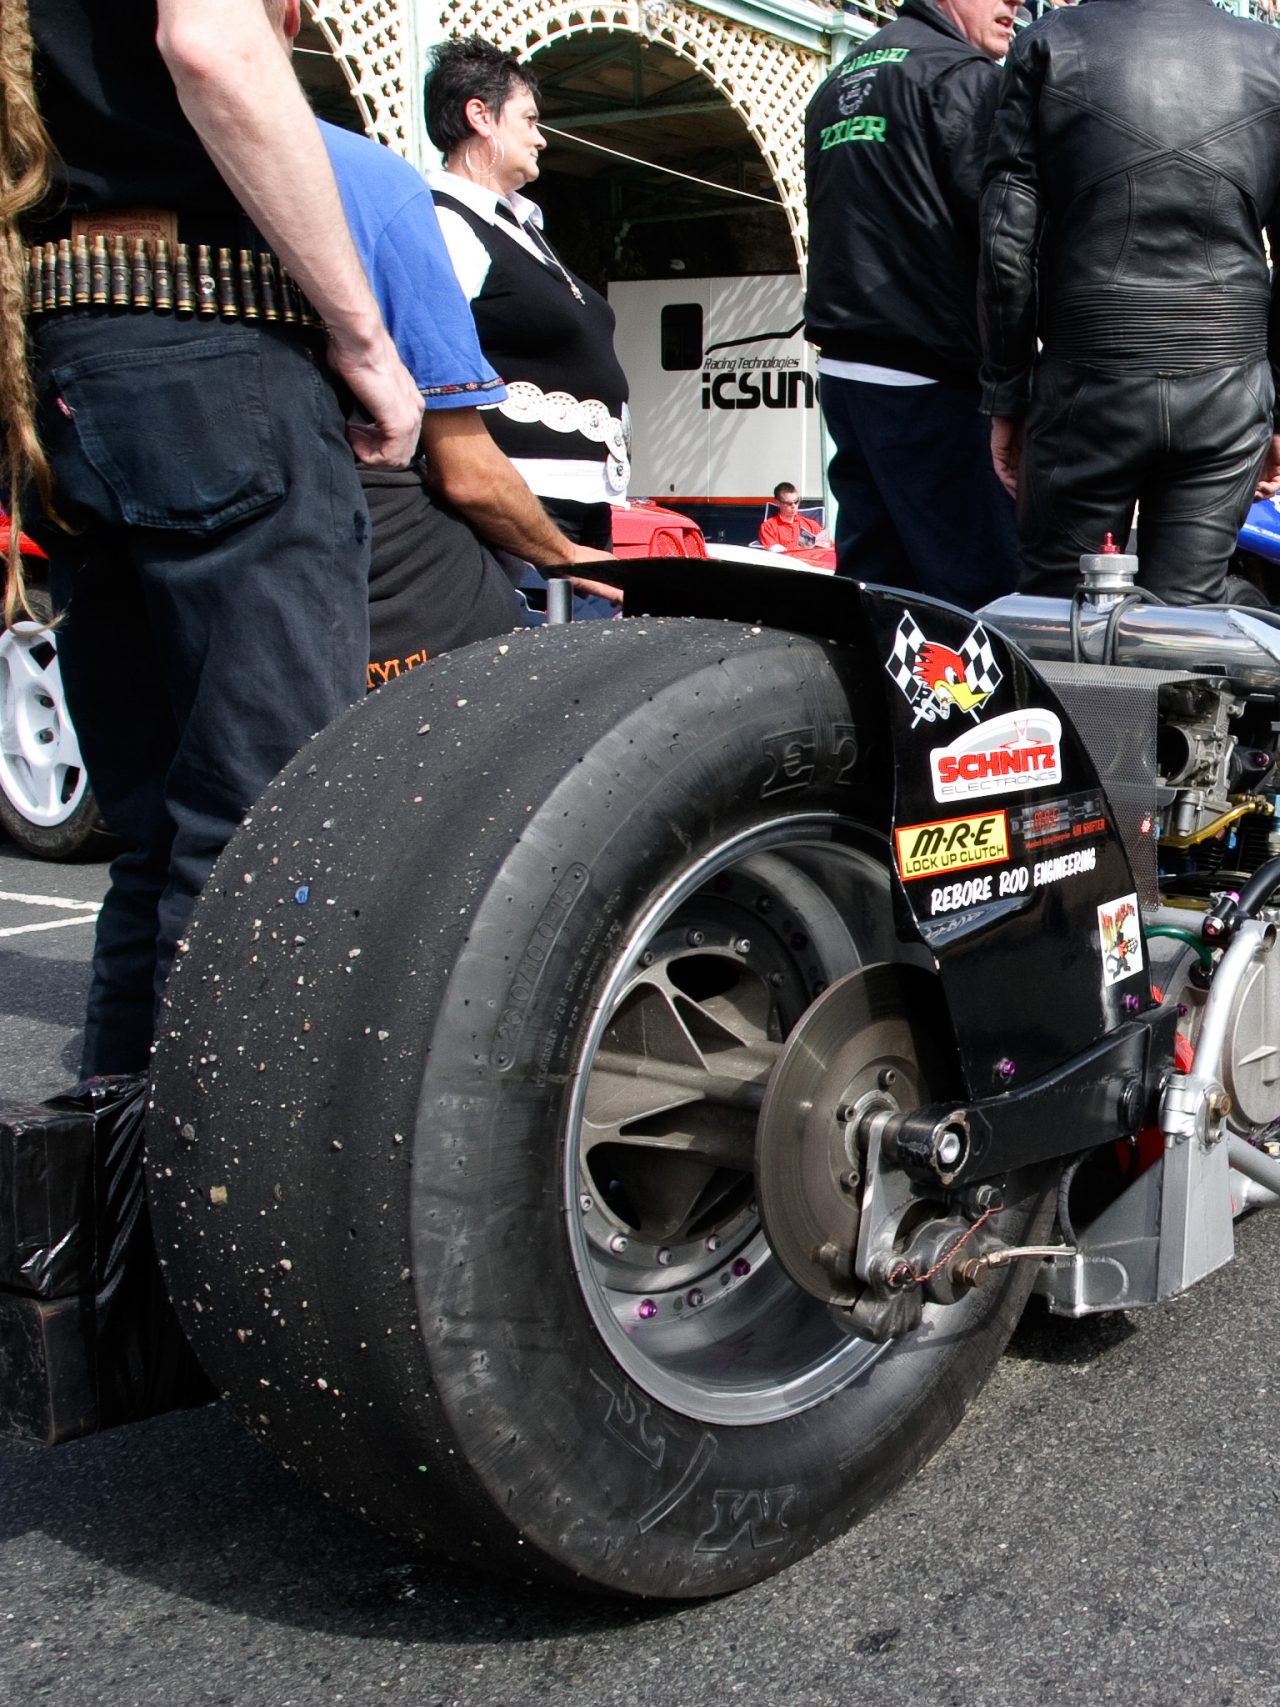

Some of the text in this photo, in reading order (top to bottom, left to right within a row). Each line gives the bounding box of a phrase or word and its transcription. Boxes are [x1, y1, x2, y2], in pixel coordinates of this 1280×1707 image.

[819, 115, 887, 151] ZX12R
[703, 355, 801, 373] Racing Technologies
[938, 744, 1056, 784] SCHNITZ
[941, 770, 1057, 796] ELECTRONICS
[905, 845, 1005, 874] LOCK UP CLUTCH
[931, 847, 1096, 916] REBORE ROD ENGINEERING
